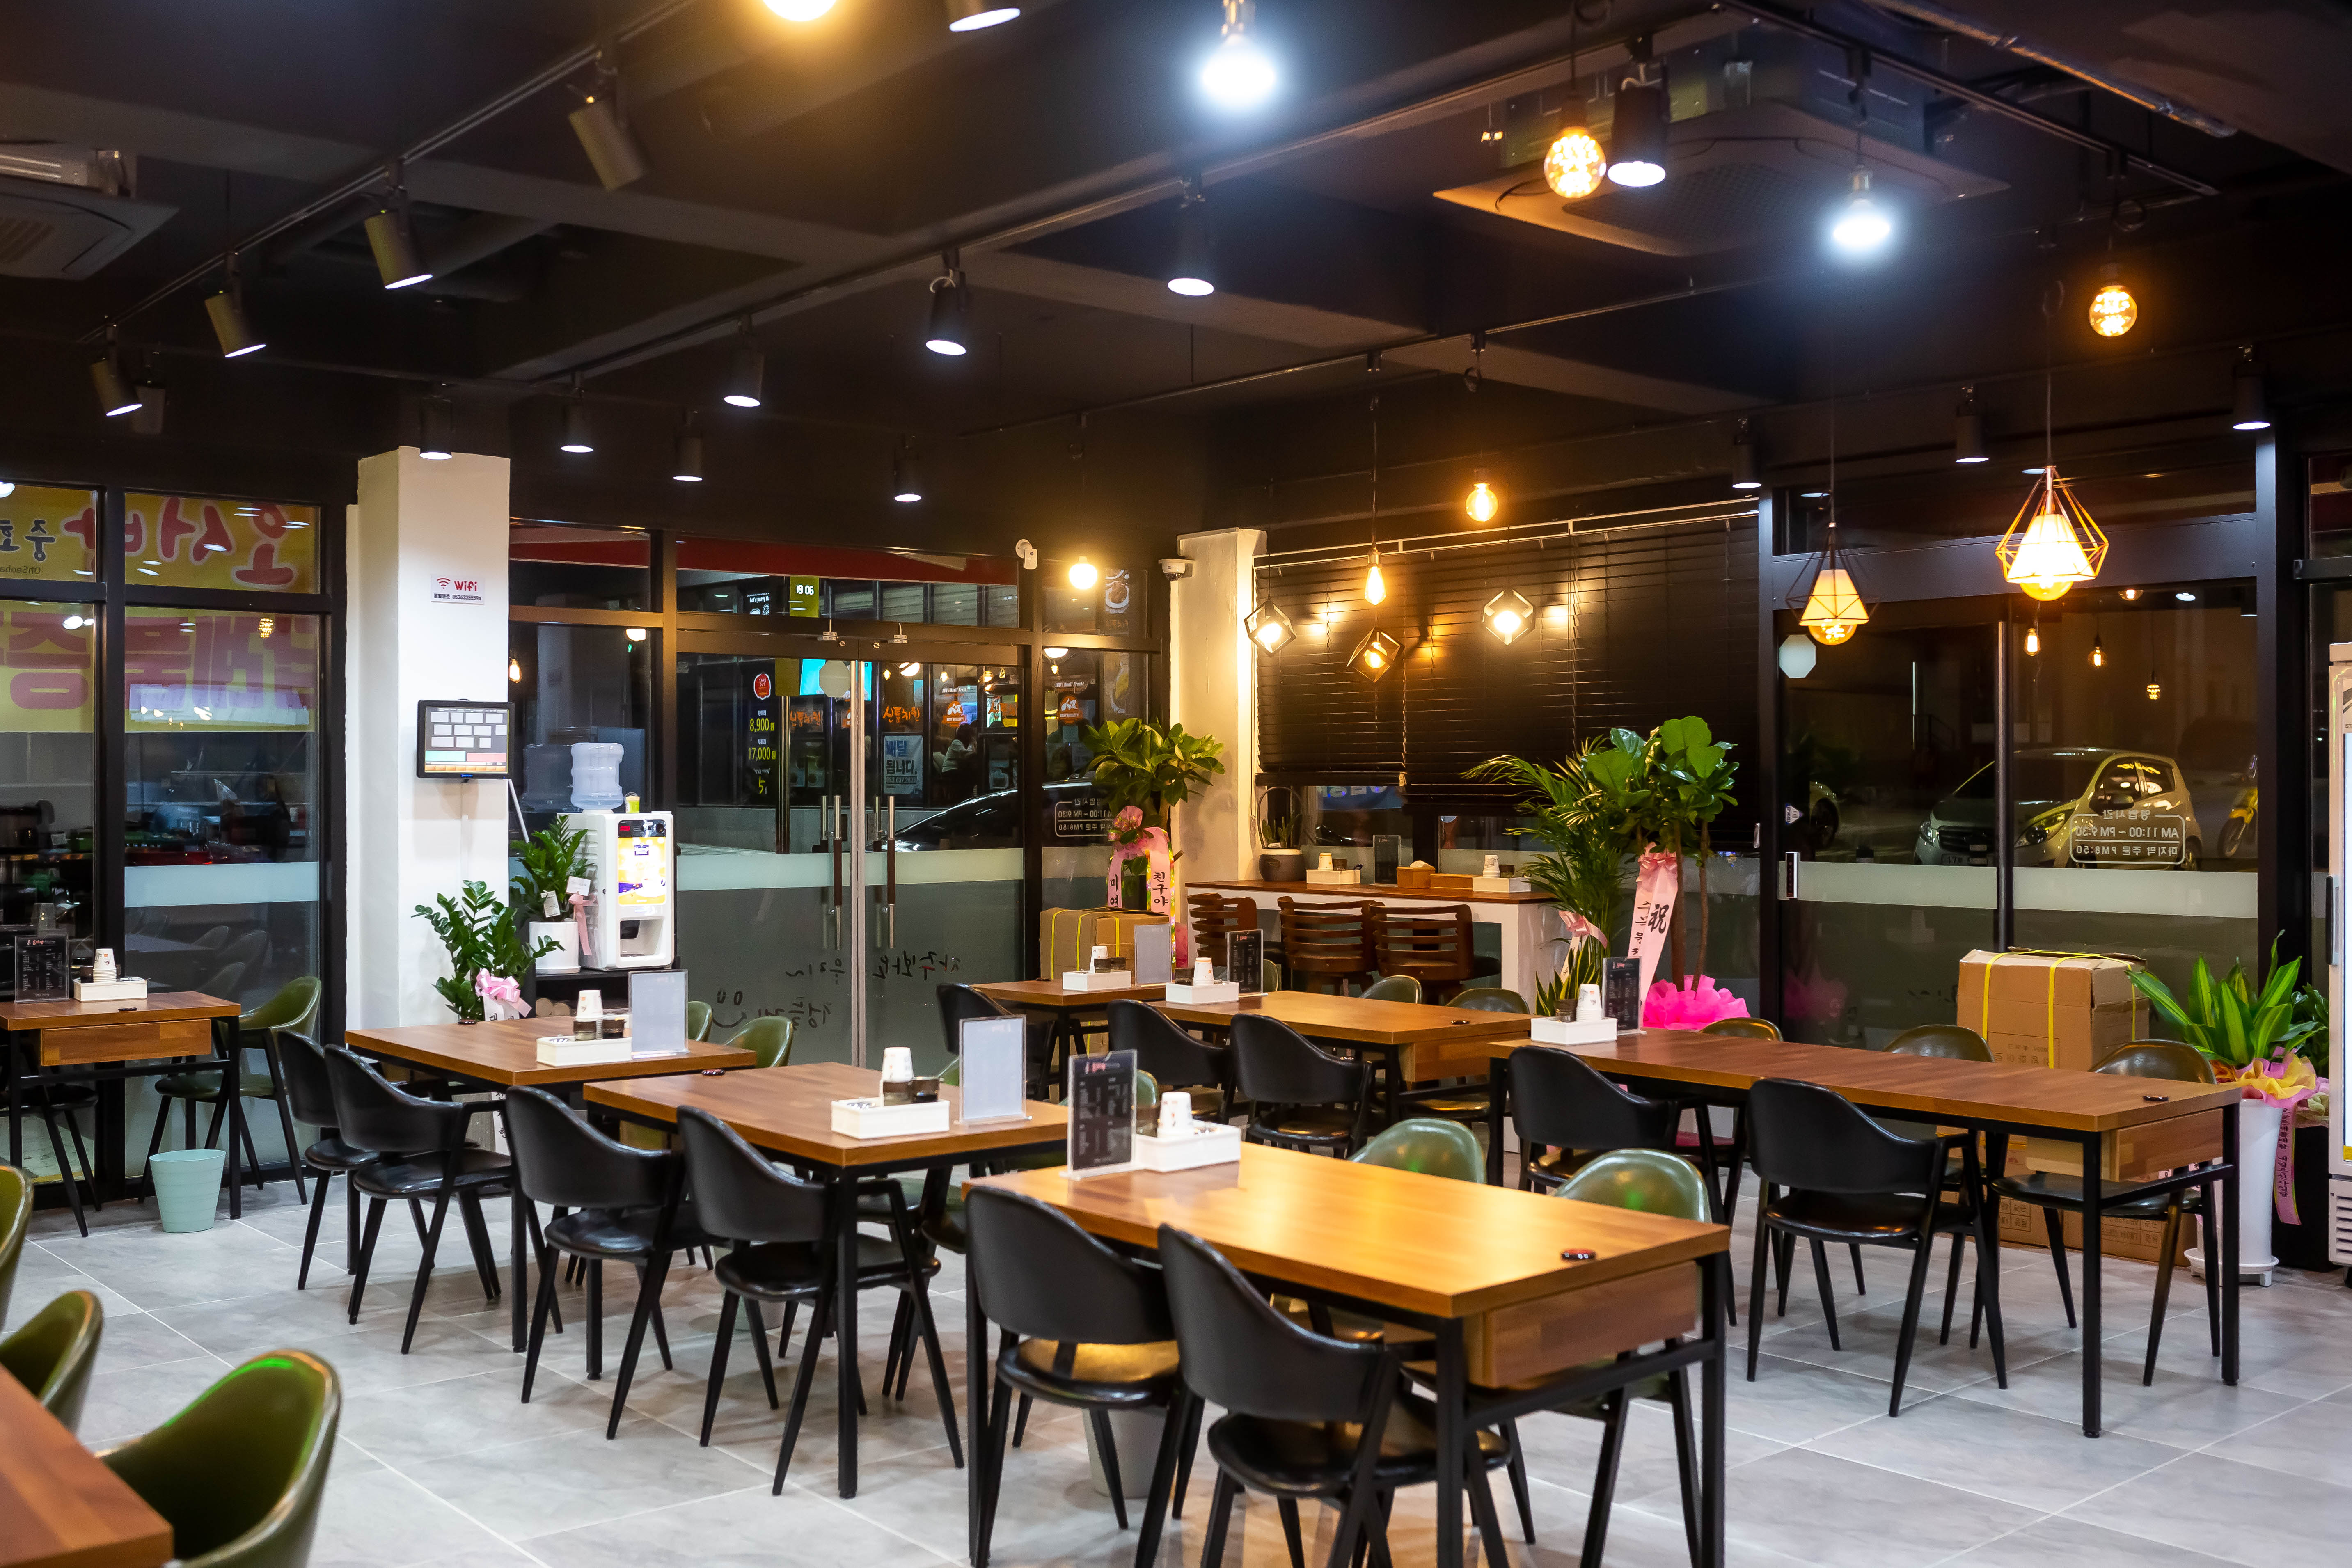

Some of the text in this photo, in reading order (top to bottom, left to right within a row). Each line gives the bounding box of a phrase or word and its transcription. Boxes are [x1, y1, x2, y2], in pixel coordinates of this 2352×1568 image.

[454, 581, 477, 591] Wifi
[1152, 871, 1168, 907] 친구야
[1648, 904, 1670, 934] 祝
